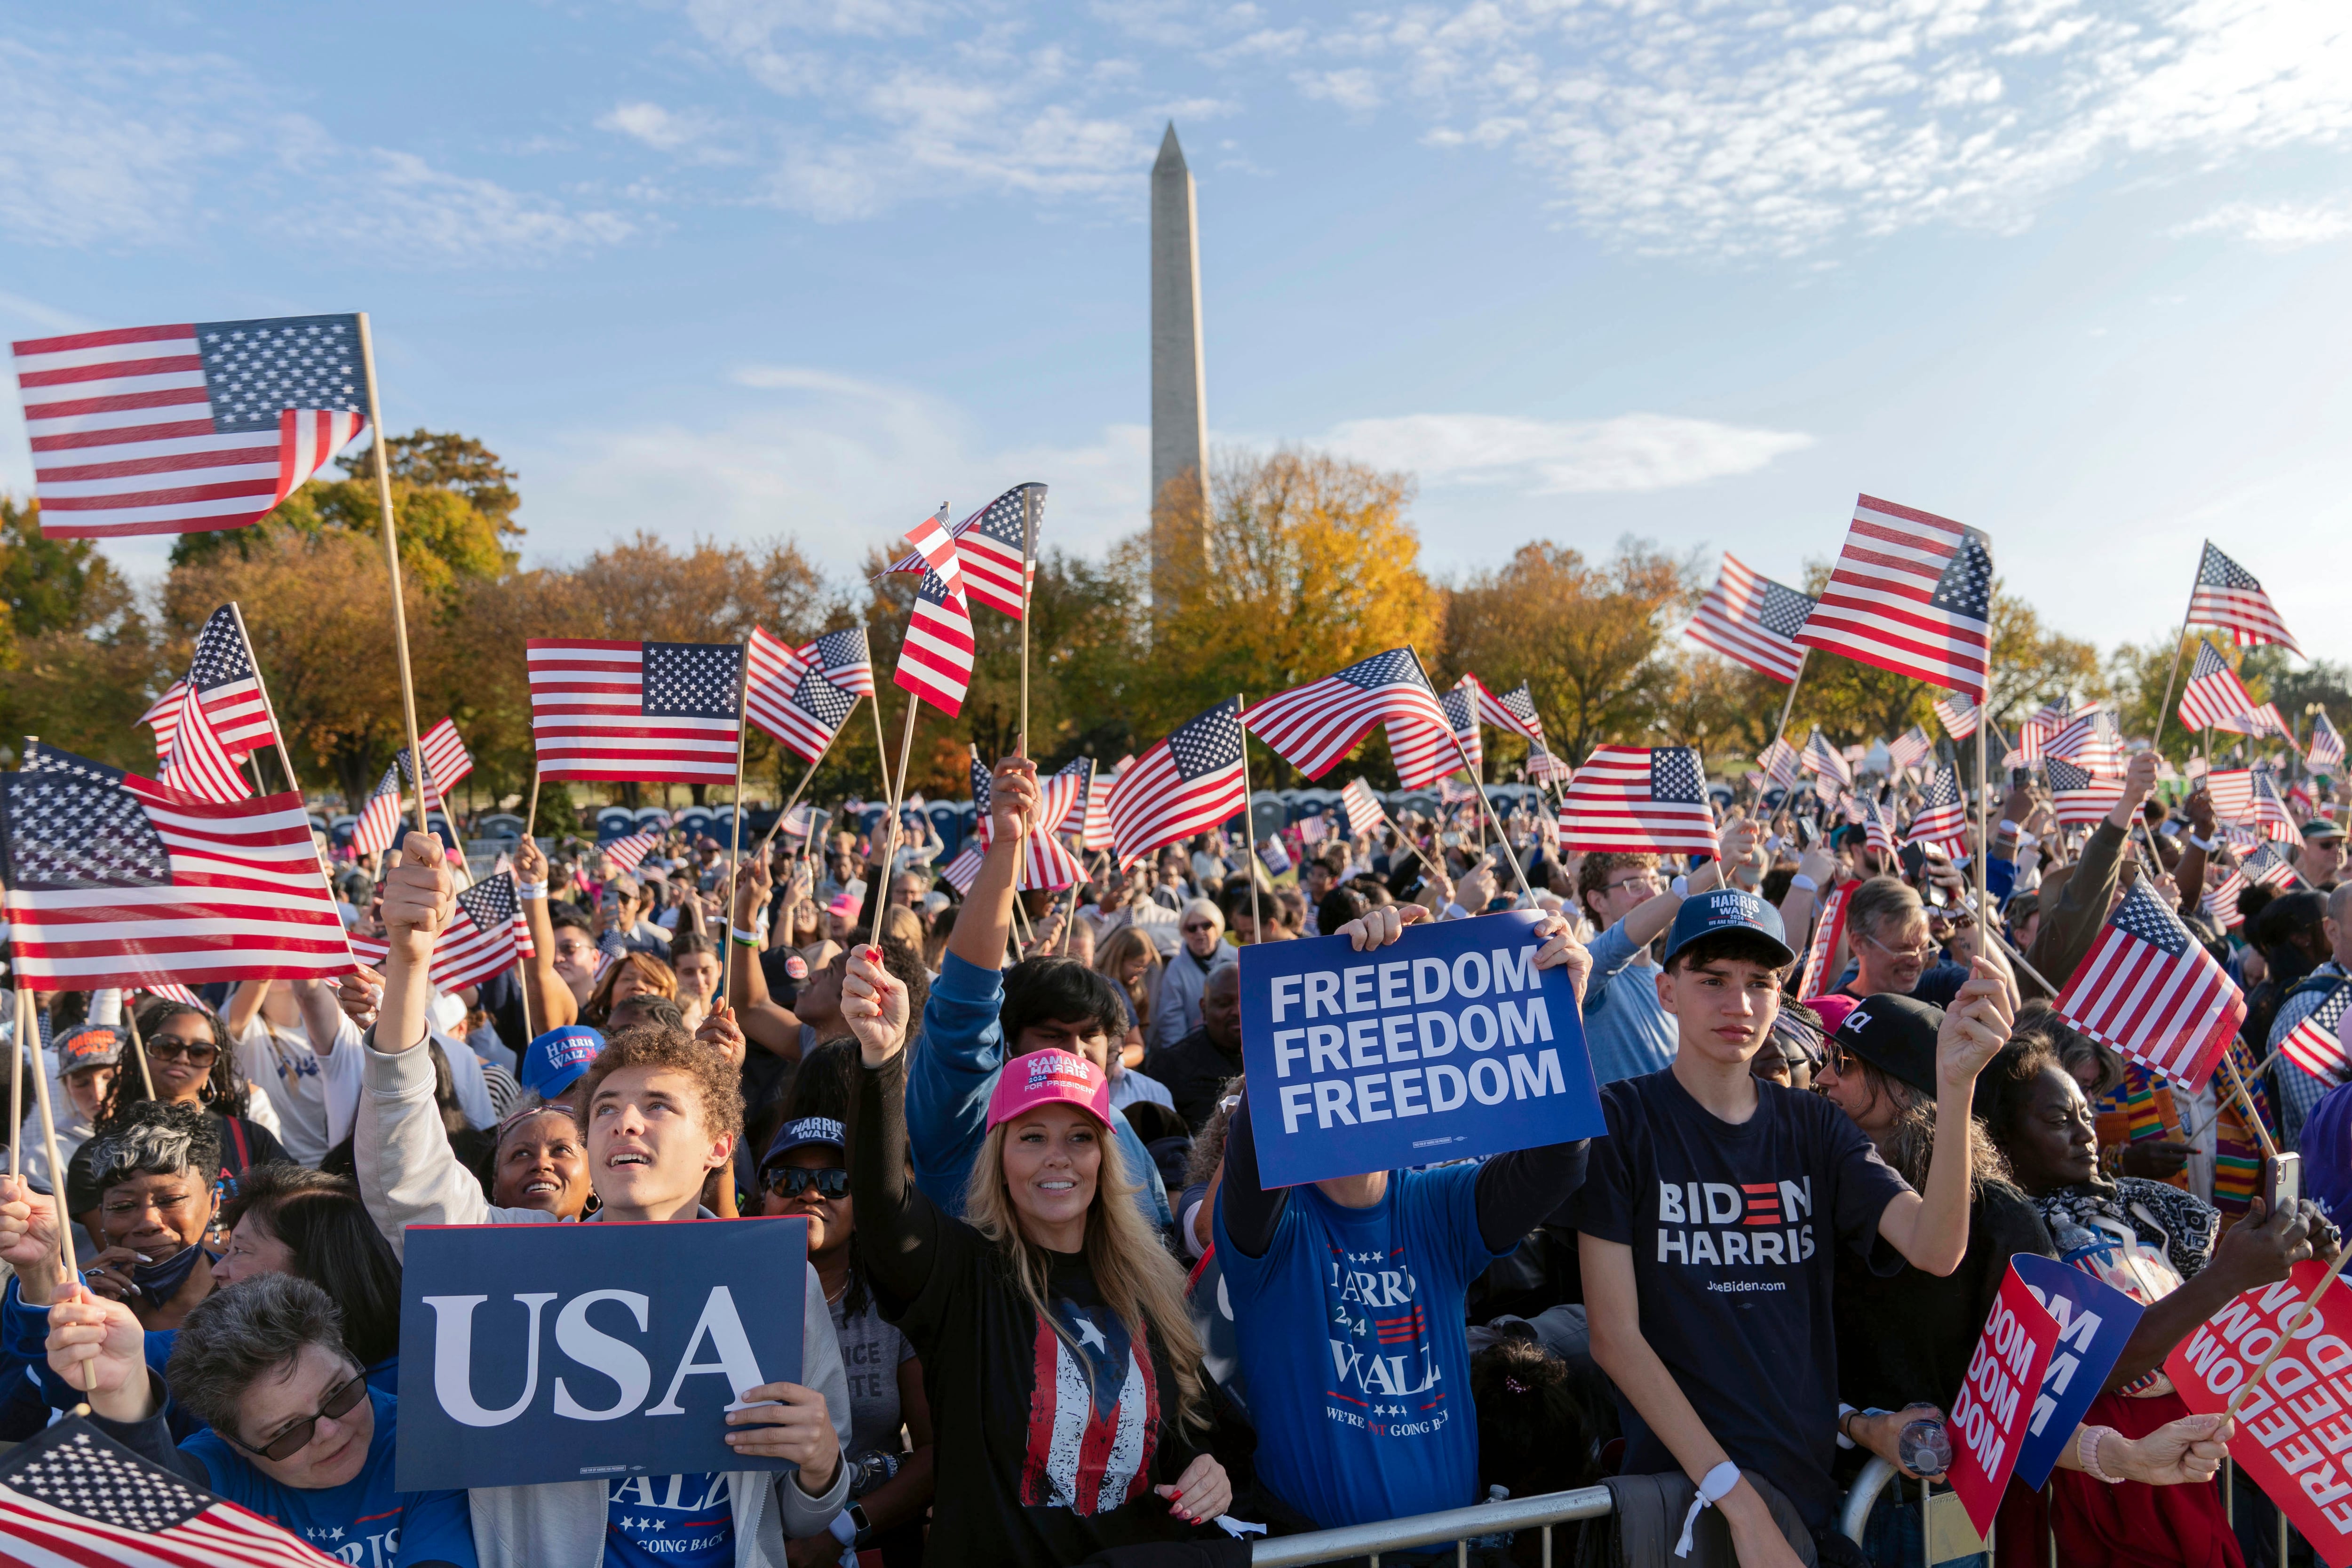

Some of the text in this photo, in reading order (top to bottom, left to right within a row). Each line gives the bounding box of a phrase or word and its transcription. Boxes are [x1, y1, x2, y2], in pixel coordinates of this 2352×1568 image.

[1711, 894, 1759, 913] HARRIS
[1720, 907, 1754, 919] WALZ
[1271, 945, 1542, 1023] FREEDOM
[68, 1030, 116, 1052] HARRIS
[1273, 996, 1554, 1078] FREEDOM
[75, 1043, 109, 1057] WALZ
[545, 1038, 595, 1060] HARRIS
[549, 1050, 585, 1070] WALZ
[1028, 1055, 1089, 1072] KAMALA
[1028, 1075, 1047, 1083] 2024
[1031, 1064, 1088, 1079] HARRIS
[1025, 1080, 1096, 1096] FOR PRESIDENT
[1279, 1048, 1566, 1134] FREEDOM
[790, 1117, 843, 1137] HARRIS
[798, 1130, 839, 1142] WALZ
[1659, 1176, 1812, 1225] BIDEN
[1657, 1225, 1815, 1265] HARRIS
[1707, 1281, 1786, 1292] JoeBiden.com
[422, 1285, 783, 1427] USA
[1326, 1406, 1365, 1429] WE'RE
[1390, 1421, 1430, 1436] GOING
[637, 1539, 687, 1553] GOING
